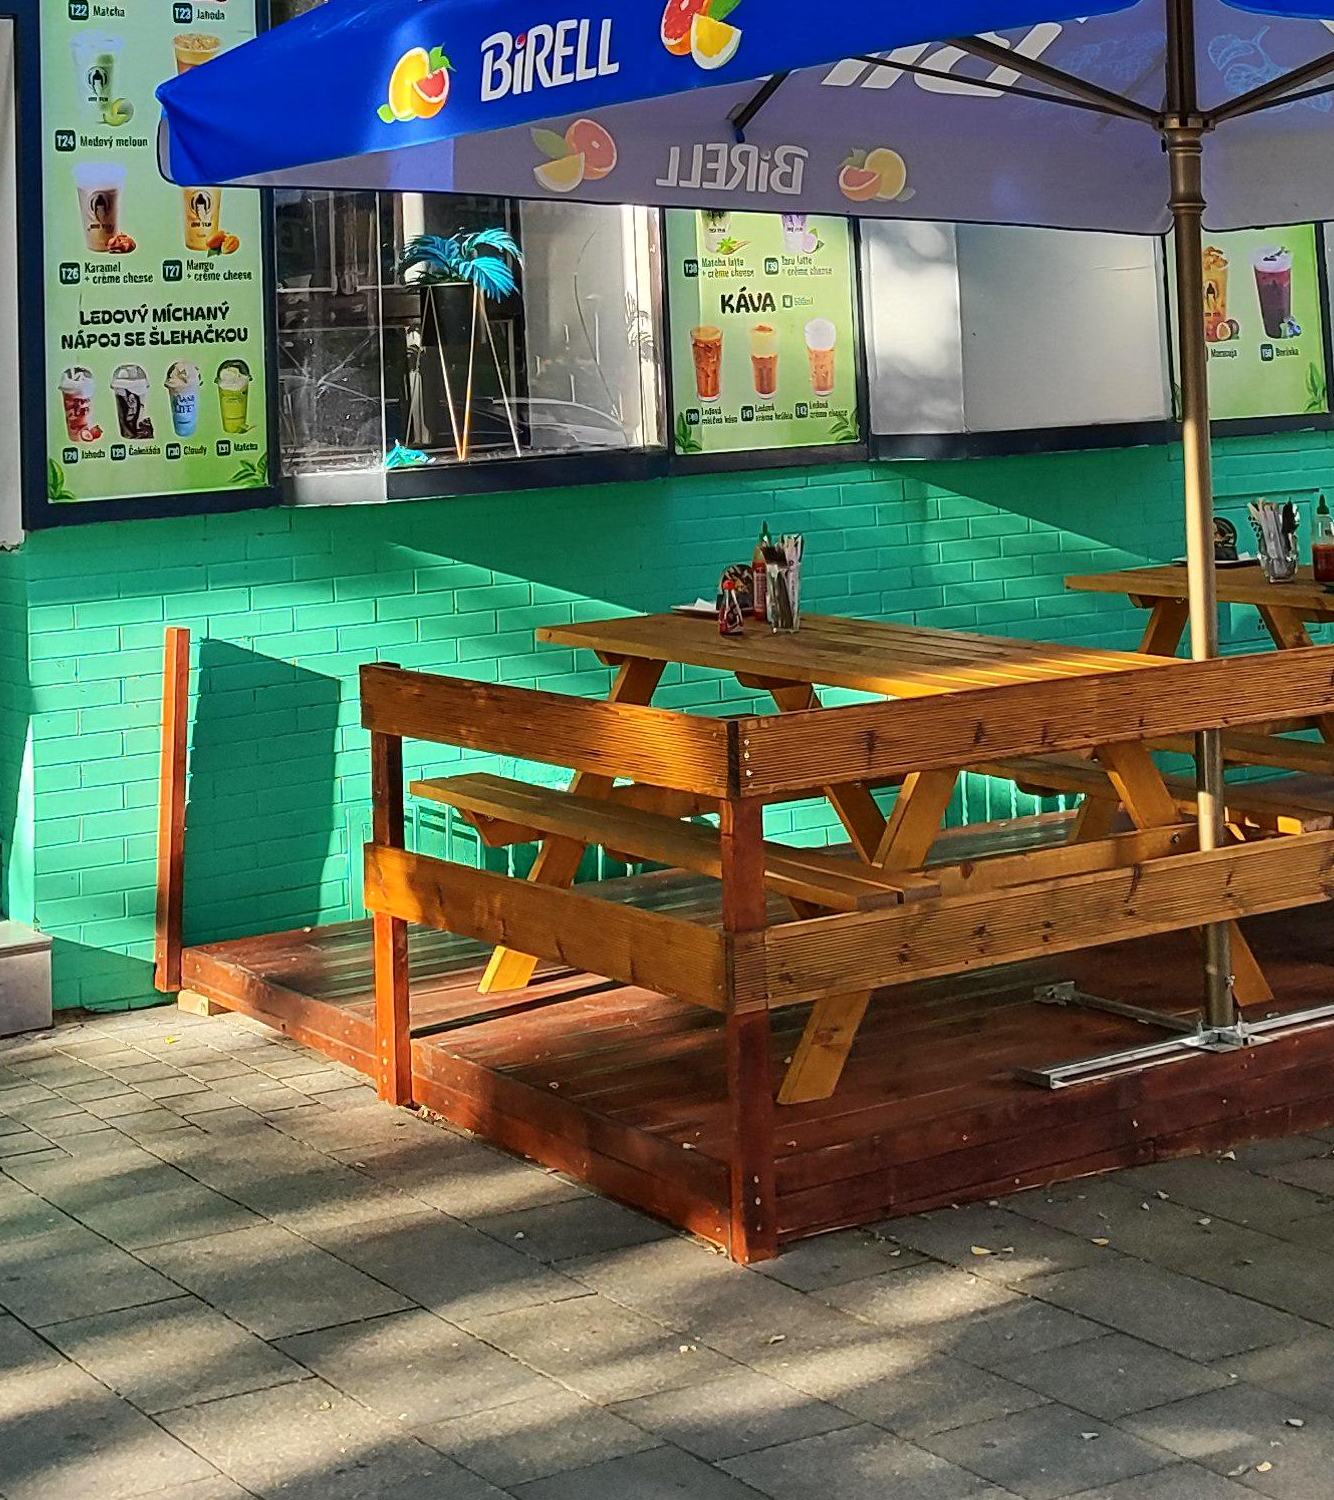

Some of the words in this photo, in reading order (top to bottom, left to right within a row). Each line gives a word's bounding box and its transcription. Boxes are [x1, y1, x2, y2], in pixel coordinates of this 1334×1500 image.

[92, 5, 125, 18] Matcha
[84, 262, 121, 274] Karamel
[186, 259, 215, 273] Mango
[720, 286, 777, 314] KÁVA
[79, 303, 149, 326] LEDOVÝ
[152, 300, 230, 323] MÍCHANÝ
[61, 329, 121, 350] NÁPOJ
[124, 331, 146, 347] SE
[149, 324, 248, 347] ŠLEHAČKOU
